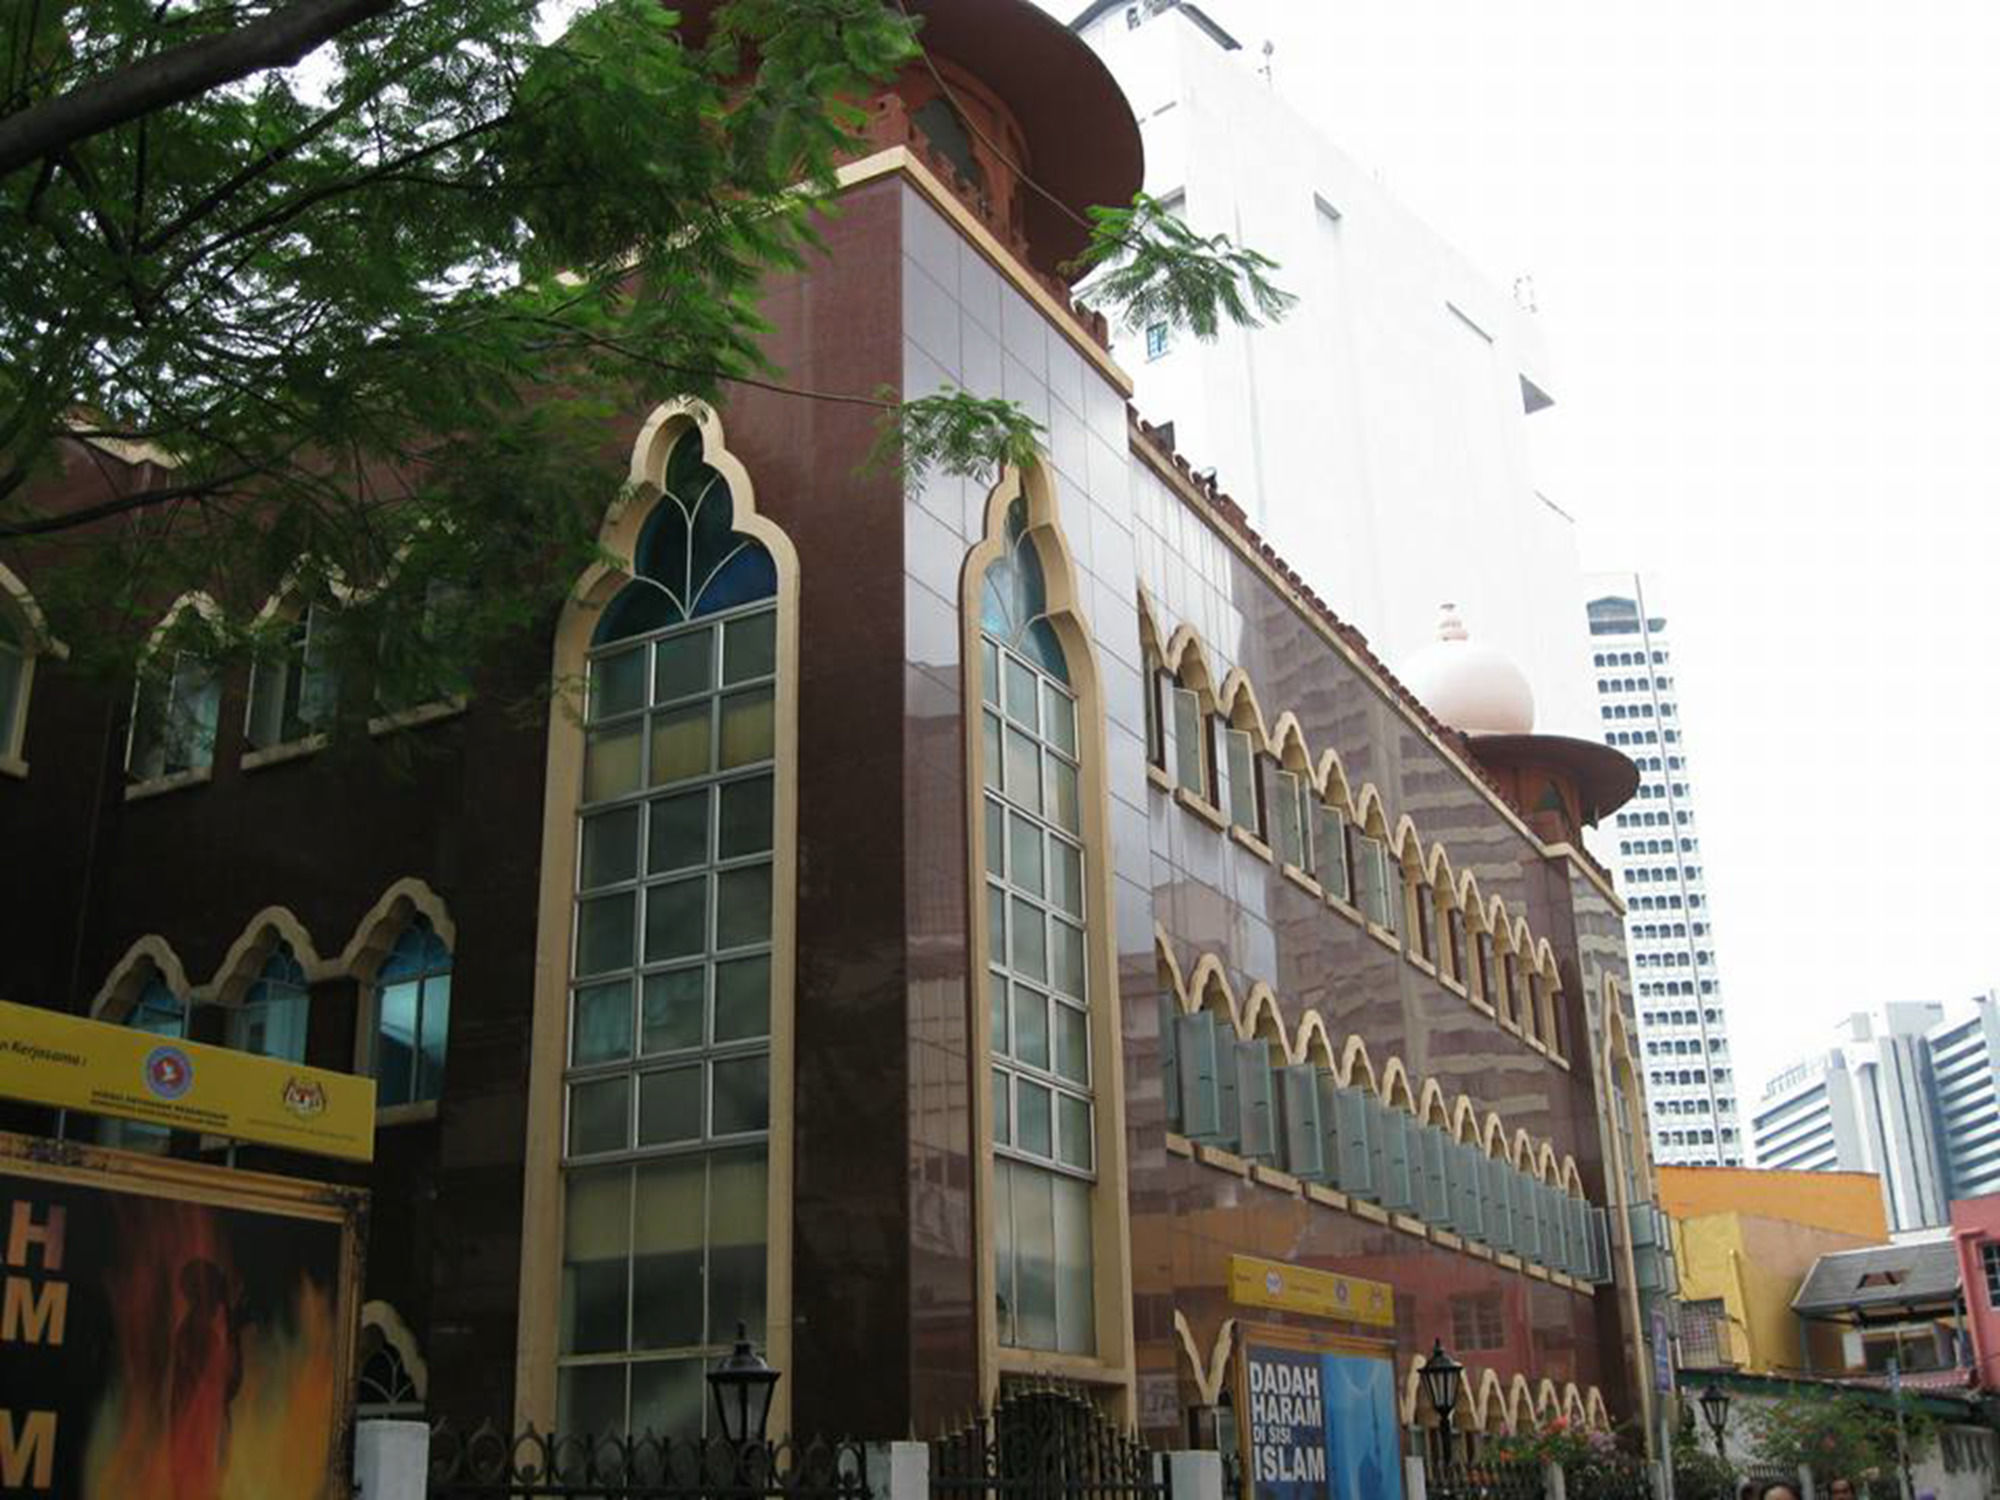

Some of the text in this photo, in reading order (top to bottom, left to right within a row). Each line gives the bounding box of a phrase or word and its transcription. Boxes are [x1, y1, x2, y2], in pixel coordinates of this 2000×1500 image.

[1, 1276, 69, 1345] M
[1250, 1361, 1320, 1397] DADAH
[1251, 1393, 1322, 1426] HARAM
[1253, 1425, 1292, 1444] DI SISI
[1254, 1446, 1326, 1482] ISLAM
